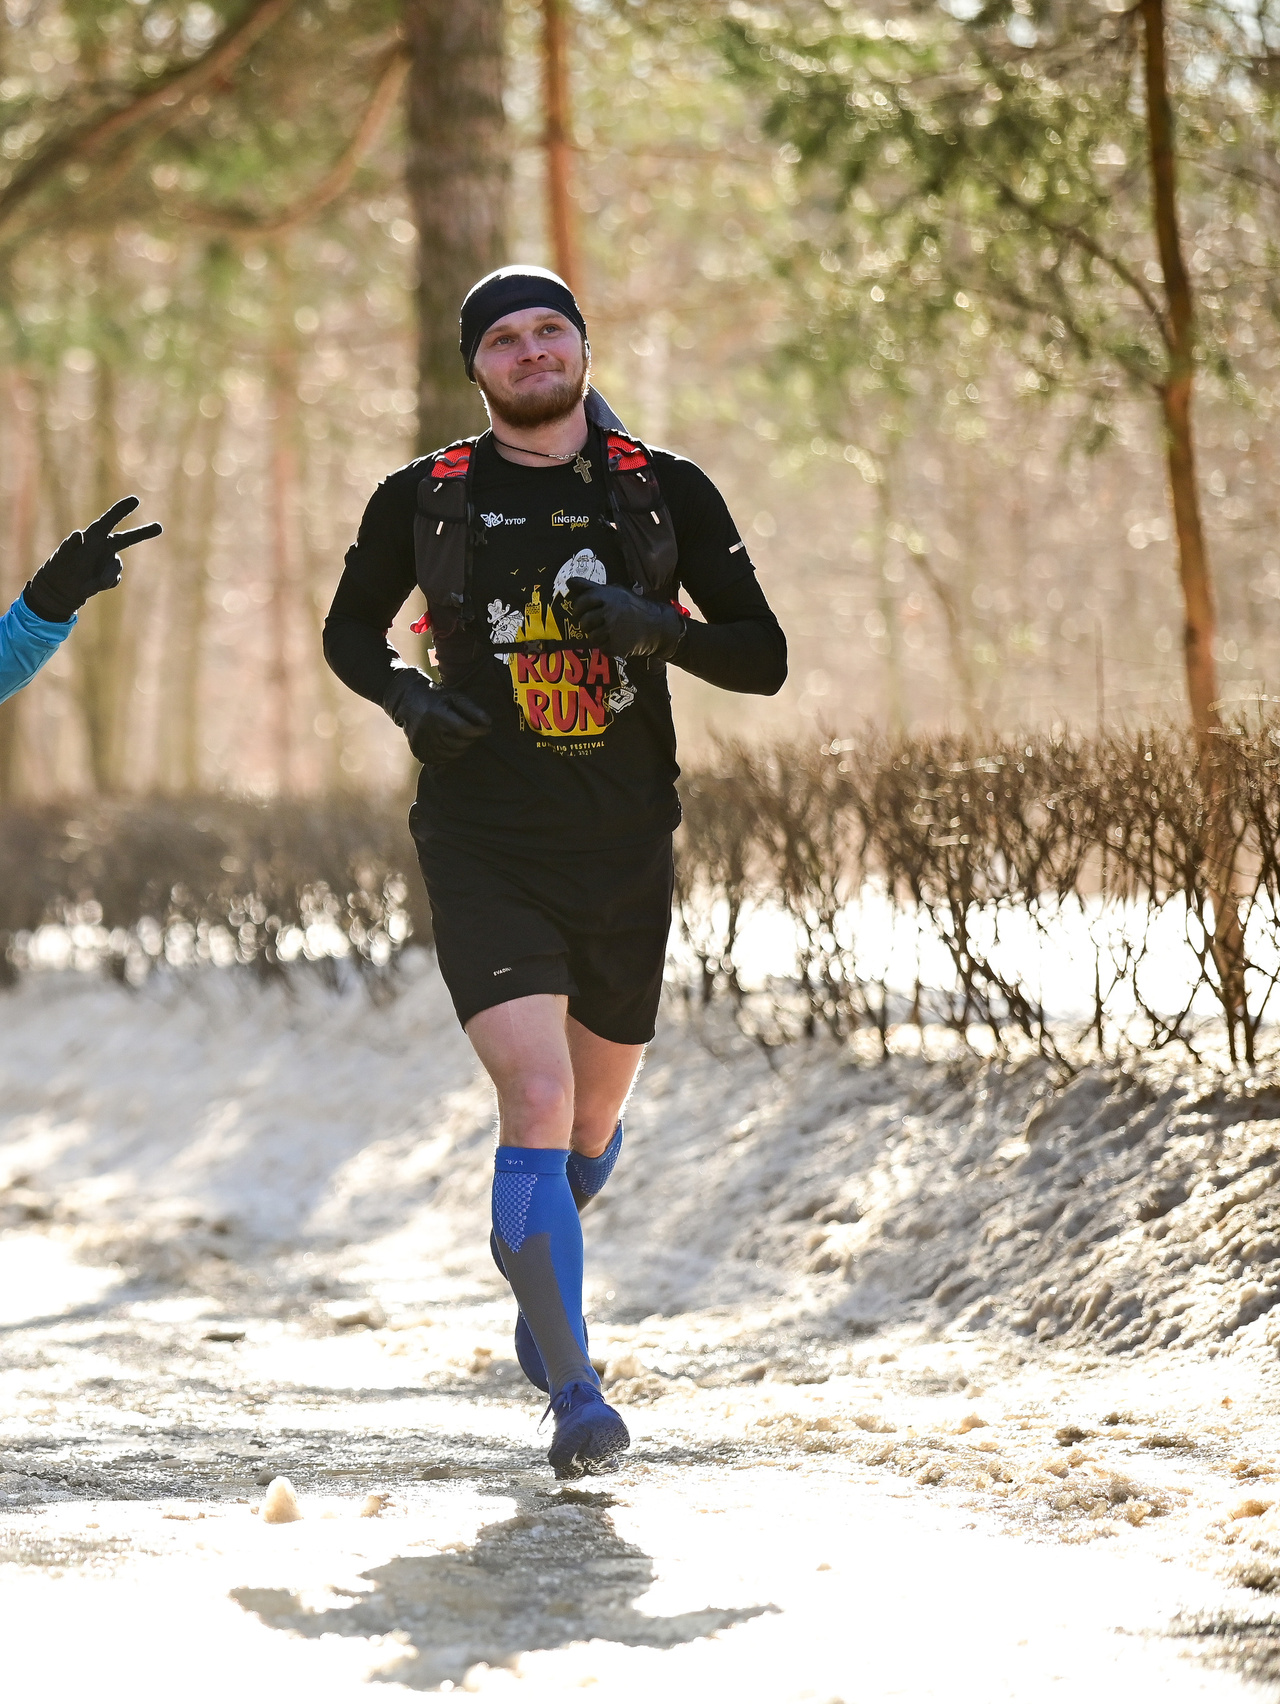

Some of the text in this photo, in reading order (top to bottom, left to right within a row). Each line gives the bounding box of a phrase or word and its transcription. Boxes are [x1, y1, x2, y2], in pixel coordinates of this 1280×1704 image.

[504, 517, 526, 526] ХУТОР
[554, 515, 590, 524] INGRAD
[517, 648, 611, 685] ROSA
[526, 685, 606, 733] RUN
[570, 741, 605, 750] FESTIVAL
